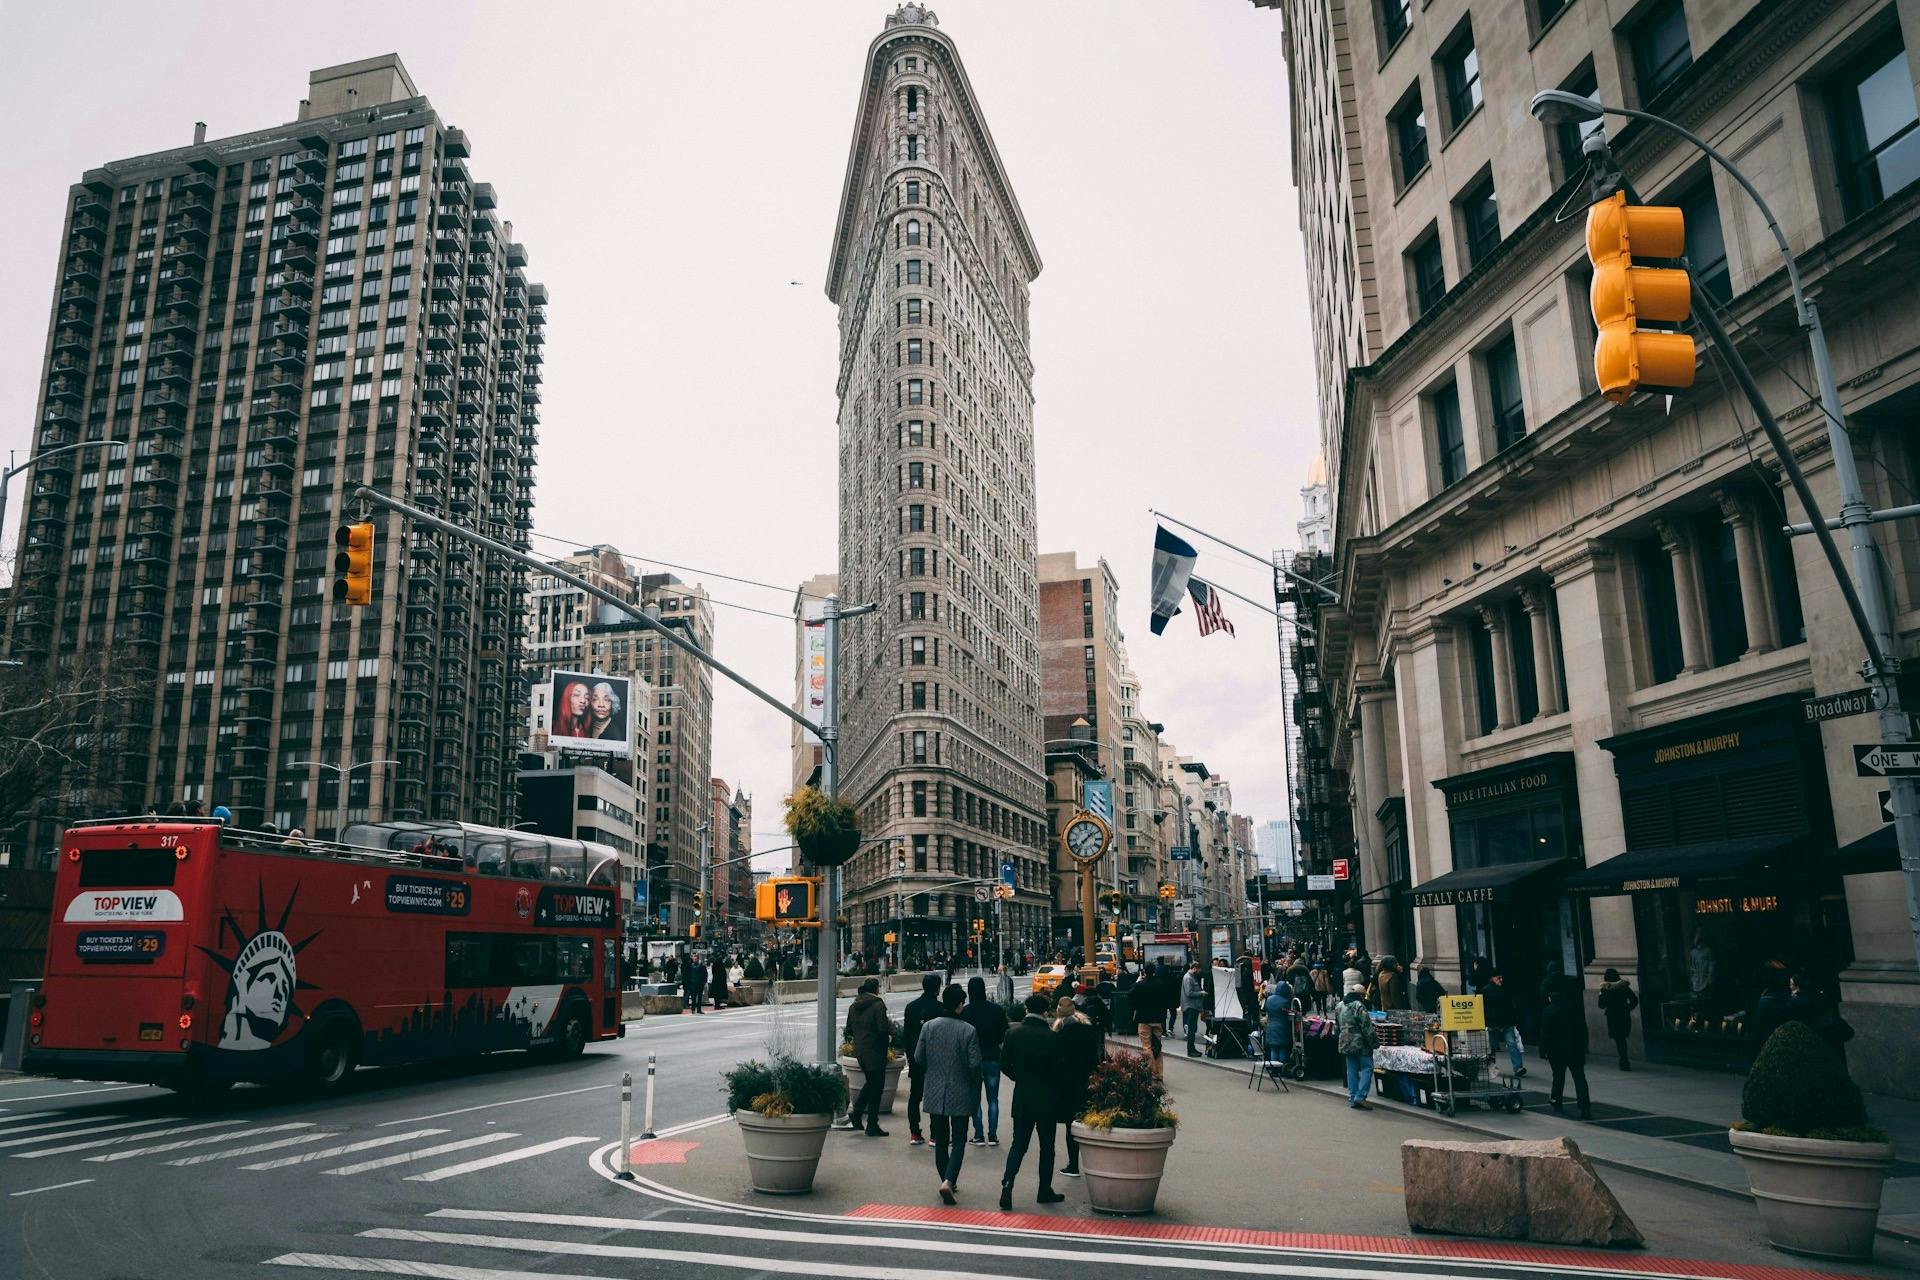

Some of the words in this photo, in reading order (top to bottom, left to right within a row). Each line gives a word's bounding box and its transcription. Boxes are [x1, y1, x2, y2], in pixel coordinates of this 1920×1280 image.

[1805, 695, 1869, 720] Broadway
[1654, 743, 1696, 764] JOHNSTON
[1703, 732, 1740, 753] MURPHY
[1870, 753, 1900, 767] ONE
[1453, 791, 1474, 804] FINE
[1477, 779, 1517, 799] ITALIAN
[1520, 773, 1547, 790] FOOD
[160, 835, 178, 847] 317
[395, 883, 408, 893] BUY
[409, 885, 433, 895] TICKETS
[433, 887, 442, 895] AT
[1622, 880, 1650, 891] JOHNSTON
[1655, 877, 1680, 889] MURPHY
[94, 896, 158, 911] TOPVIEW
[1415, 890, 1452, 906] EATALY
[1458, 887, 1494, 903] CAFFE
[553, 895, 604, 915] TOPVIEW
[1451, 1000, 1474, 1010] Lego
